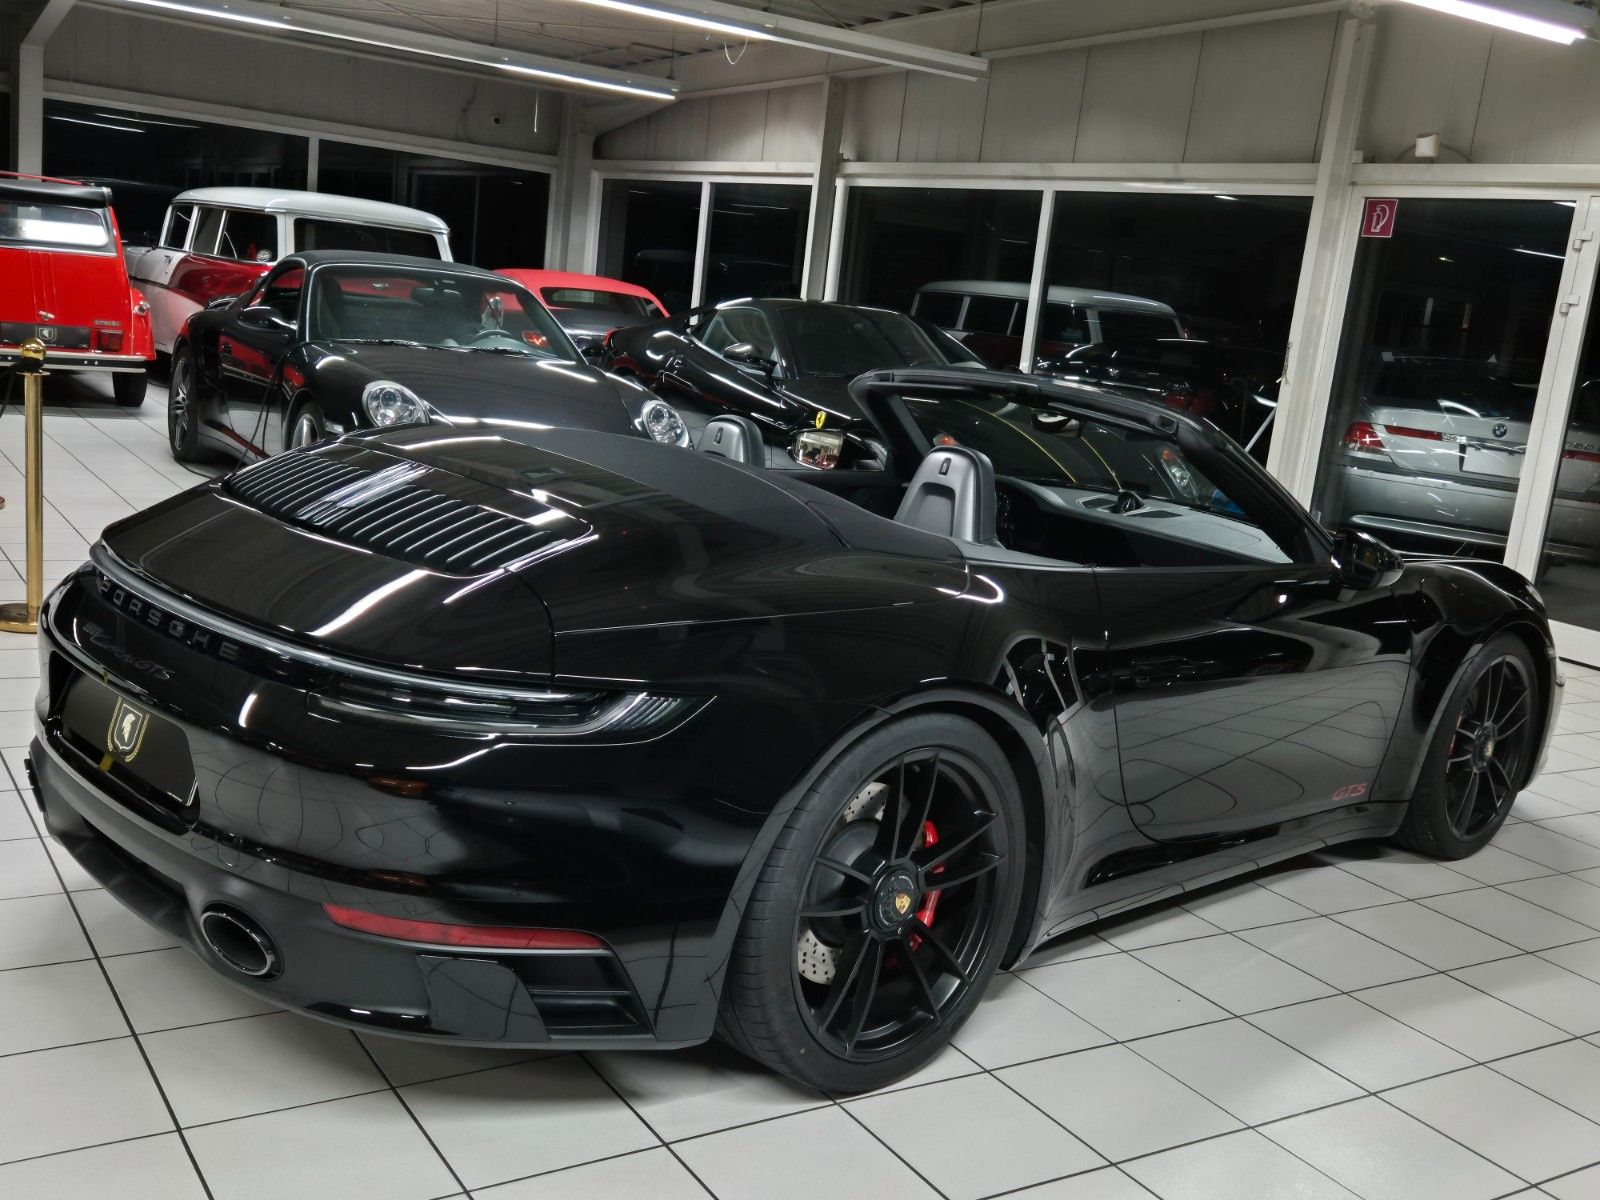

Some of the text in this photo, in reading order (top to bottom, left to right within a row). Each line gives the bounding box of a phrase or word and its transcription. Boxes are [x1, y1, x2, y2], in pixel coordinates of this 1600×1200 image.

[98, 577, 240, 660] PORSCHE
[133, 660, 177, 681] GTS
[1332, 783, 1368, 801] GTS
